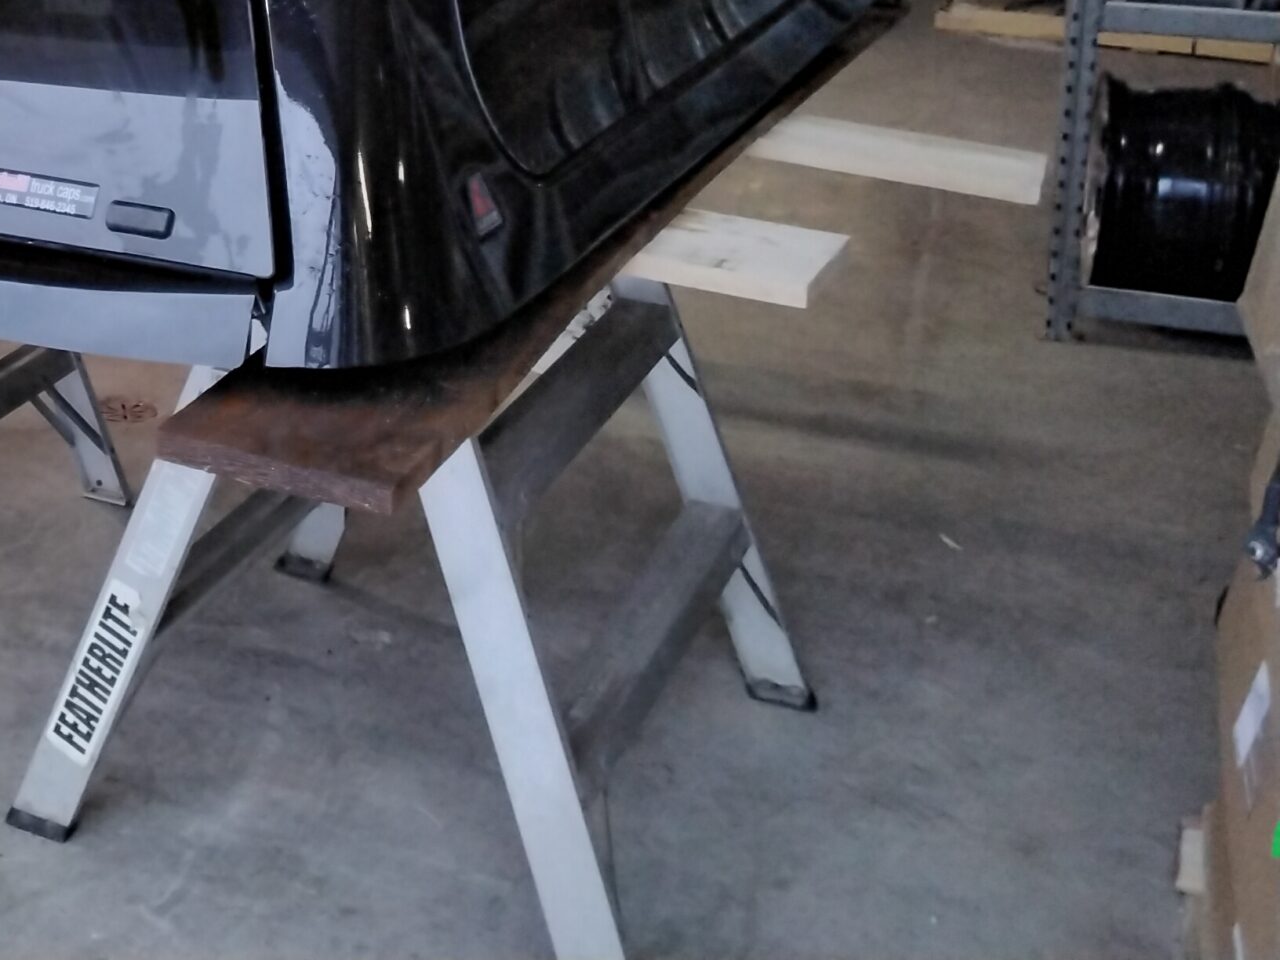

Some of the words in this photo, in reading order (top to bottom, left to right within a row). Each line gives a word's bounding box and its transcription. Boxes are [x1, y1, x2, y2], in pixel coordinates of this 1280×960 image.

[29, 178, 55, 196] truck
[55, 185, 82, 203] caps
[52, 593, 138, 755] FEATHERLITE
